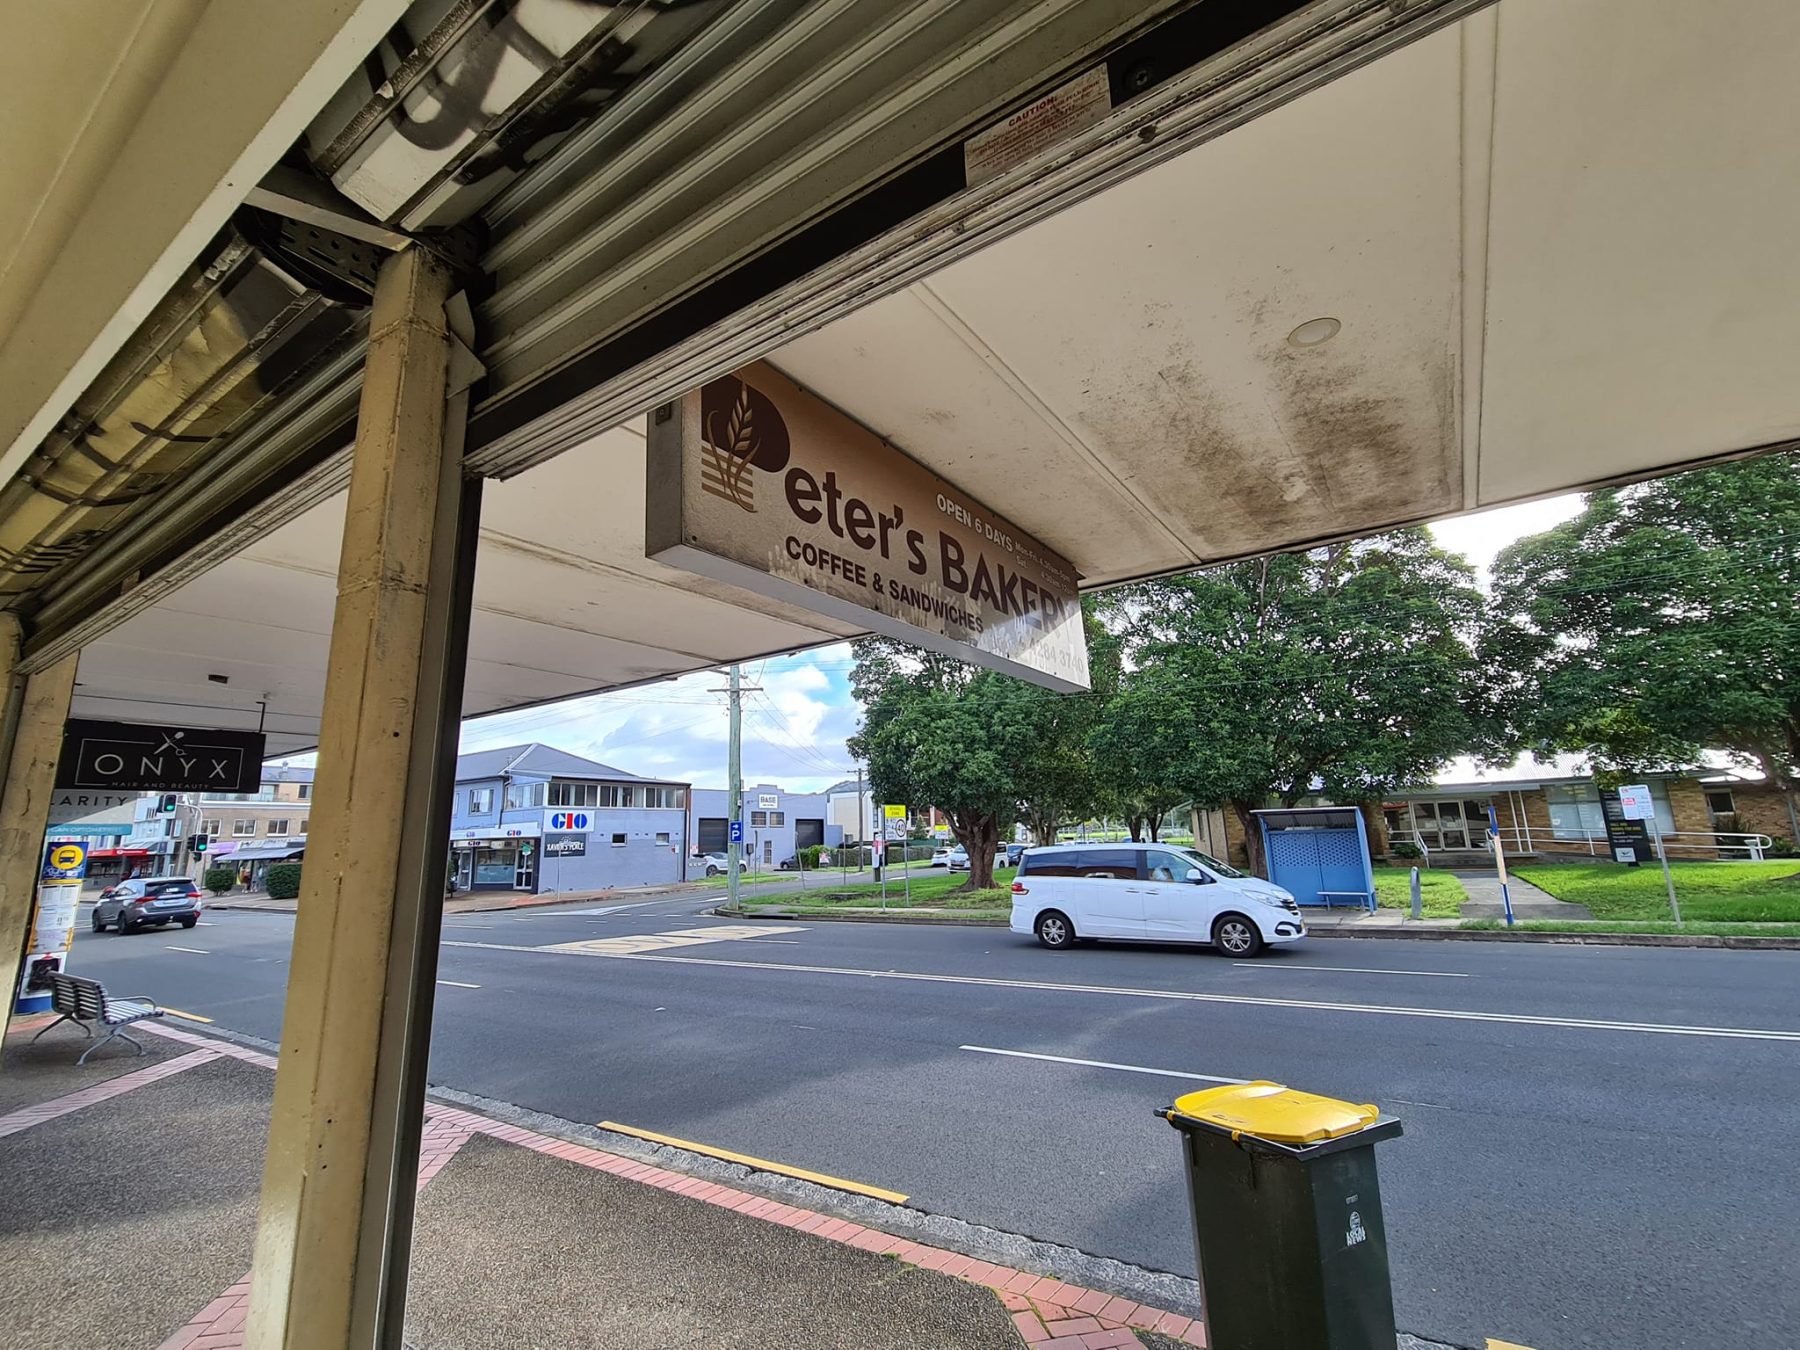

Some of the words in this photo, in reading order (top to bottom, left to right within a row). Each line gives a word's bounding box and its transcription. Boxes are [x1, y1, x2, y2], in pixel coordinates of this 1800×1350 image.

[936, 493, 972, 528] OPEN
[974, 518, 983, 534] 6
[985, 523, 1013, 552] DAYS
[785, 536, 867, 588] COFFEE
[872, 572, 885, 595] &
[889, 579, 984, 634] SANDWICHES
[94, 753, 228, 779] ONYX
[170, 782, 210, 790] BEAUTY
[51, 795, 128, 807] ARITY
[551, 812, 588, 830] GIO
[506, 829, 522, 837] GIO
[731, 830, 740, 840] P
